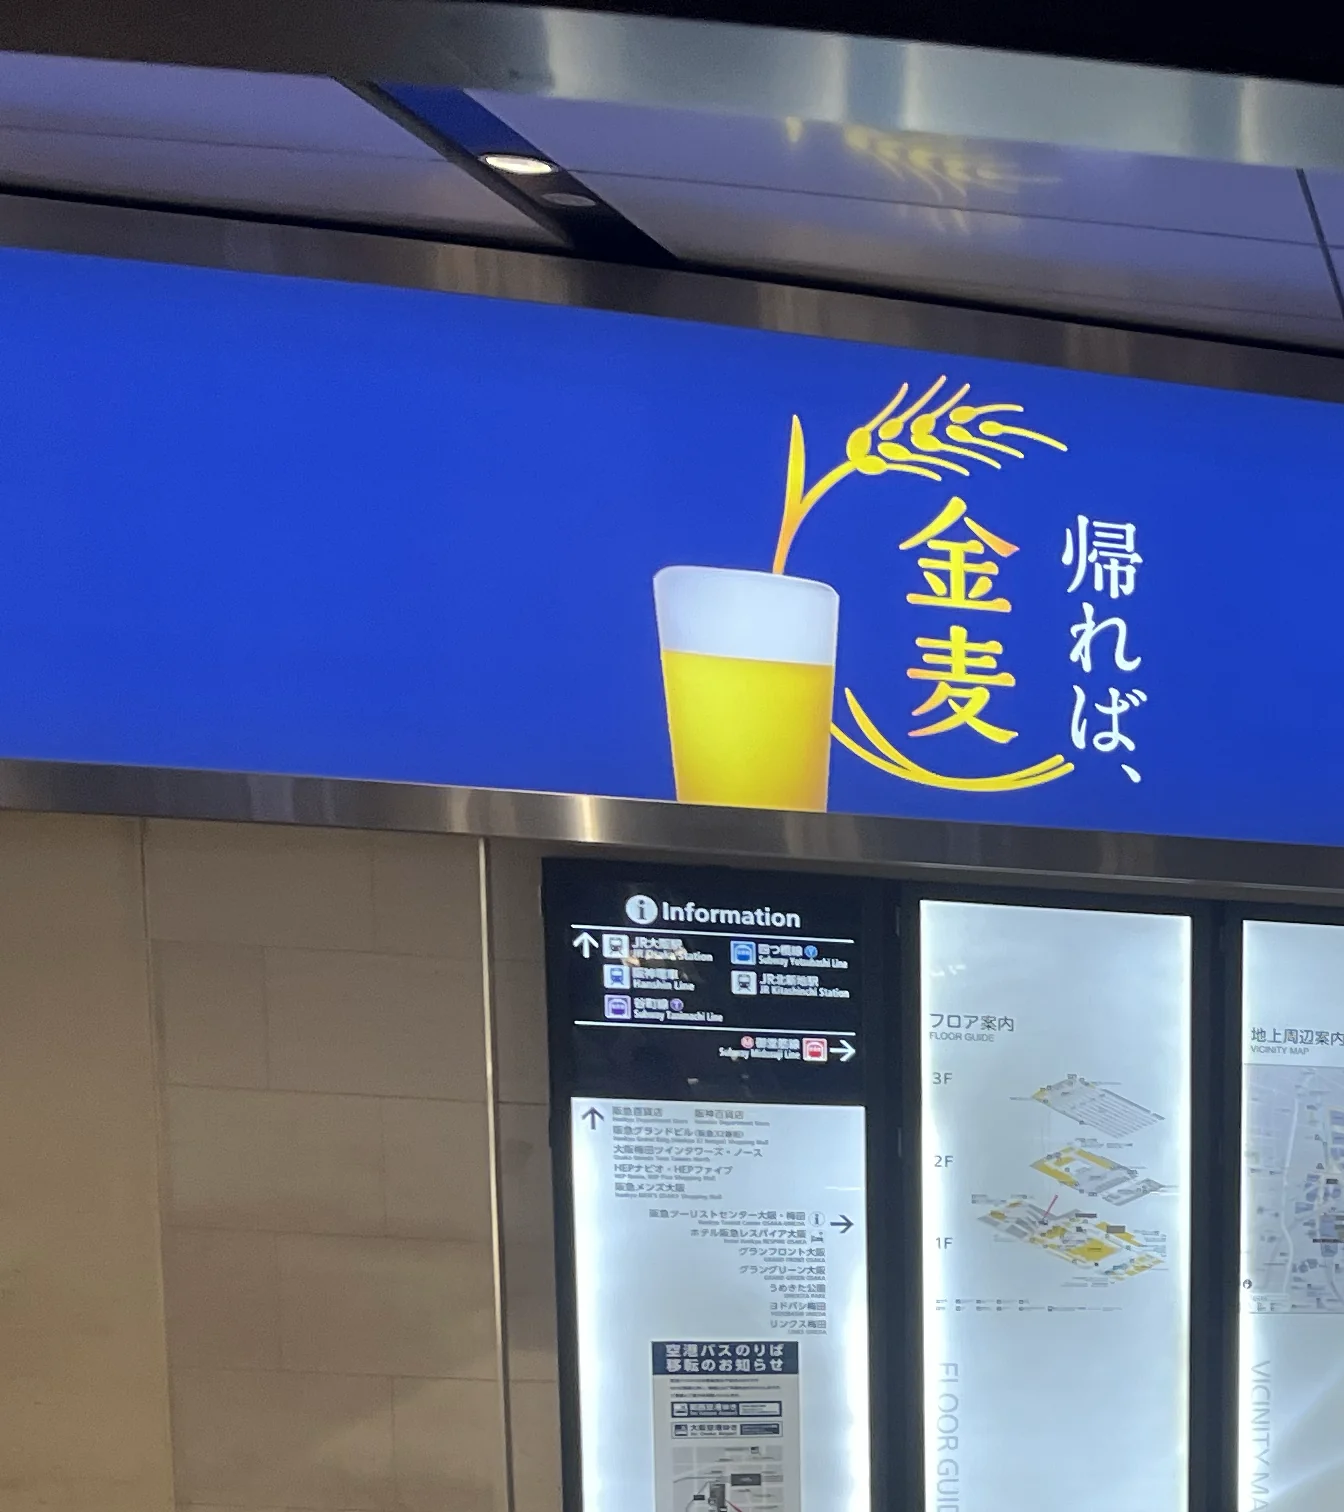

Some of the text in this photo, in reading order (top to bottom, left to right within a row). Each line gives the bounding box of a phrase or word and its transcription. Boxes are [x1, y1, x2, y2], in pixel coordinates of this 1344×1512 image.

[899, 496, 1020, 744] 金麦
[1061, 514, 1147, 783] 帰れば、
[662, 902, 801, 928] Information
[929, 1013, 1014, 1032] フロア案内
[1289, 1047, 1310, 1055] MAP
[932, 1072, 953, 1086] 3F
[934, 1155, 954, 1168] 2F
[935, 1237, 953, 1249] 1F
[666, 1344, 784, 1357] 空港バスのりば
[666, 1358, 784, 1372] 移転のお知らせ
[1251, 1360, 1271, 1466] VICINITY
